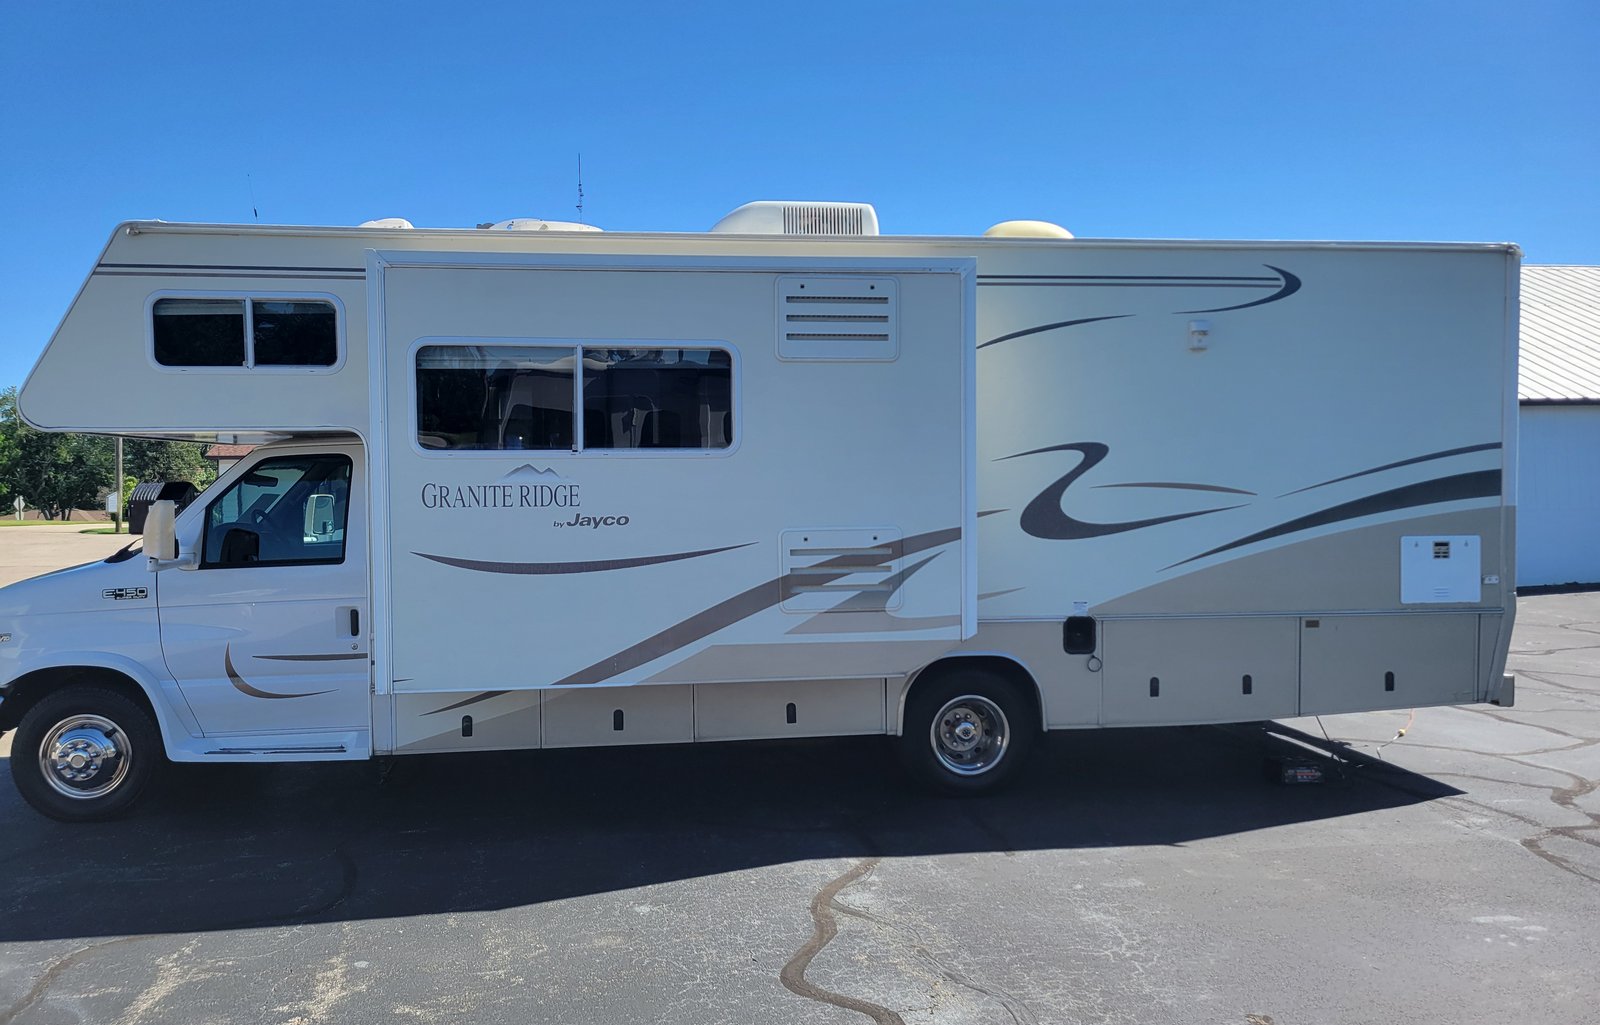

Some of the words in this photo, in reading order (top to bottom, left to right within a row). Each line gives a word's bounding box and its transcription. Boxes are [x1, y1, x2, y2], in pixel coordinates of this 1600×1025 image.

[421, 483, 513, 508] GRANITE
[519, 484, 581, 507] RIDGE
[553, 520, 565, 529] by
[566, 513, 630, 529] Jayco
